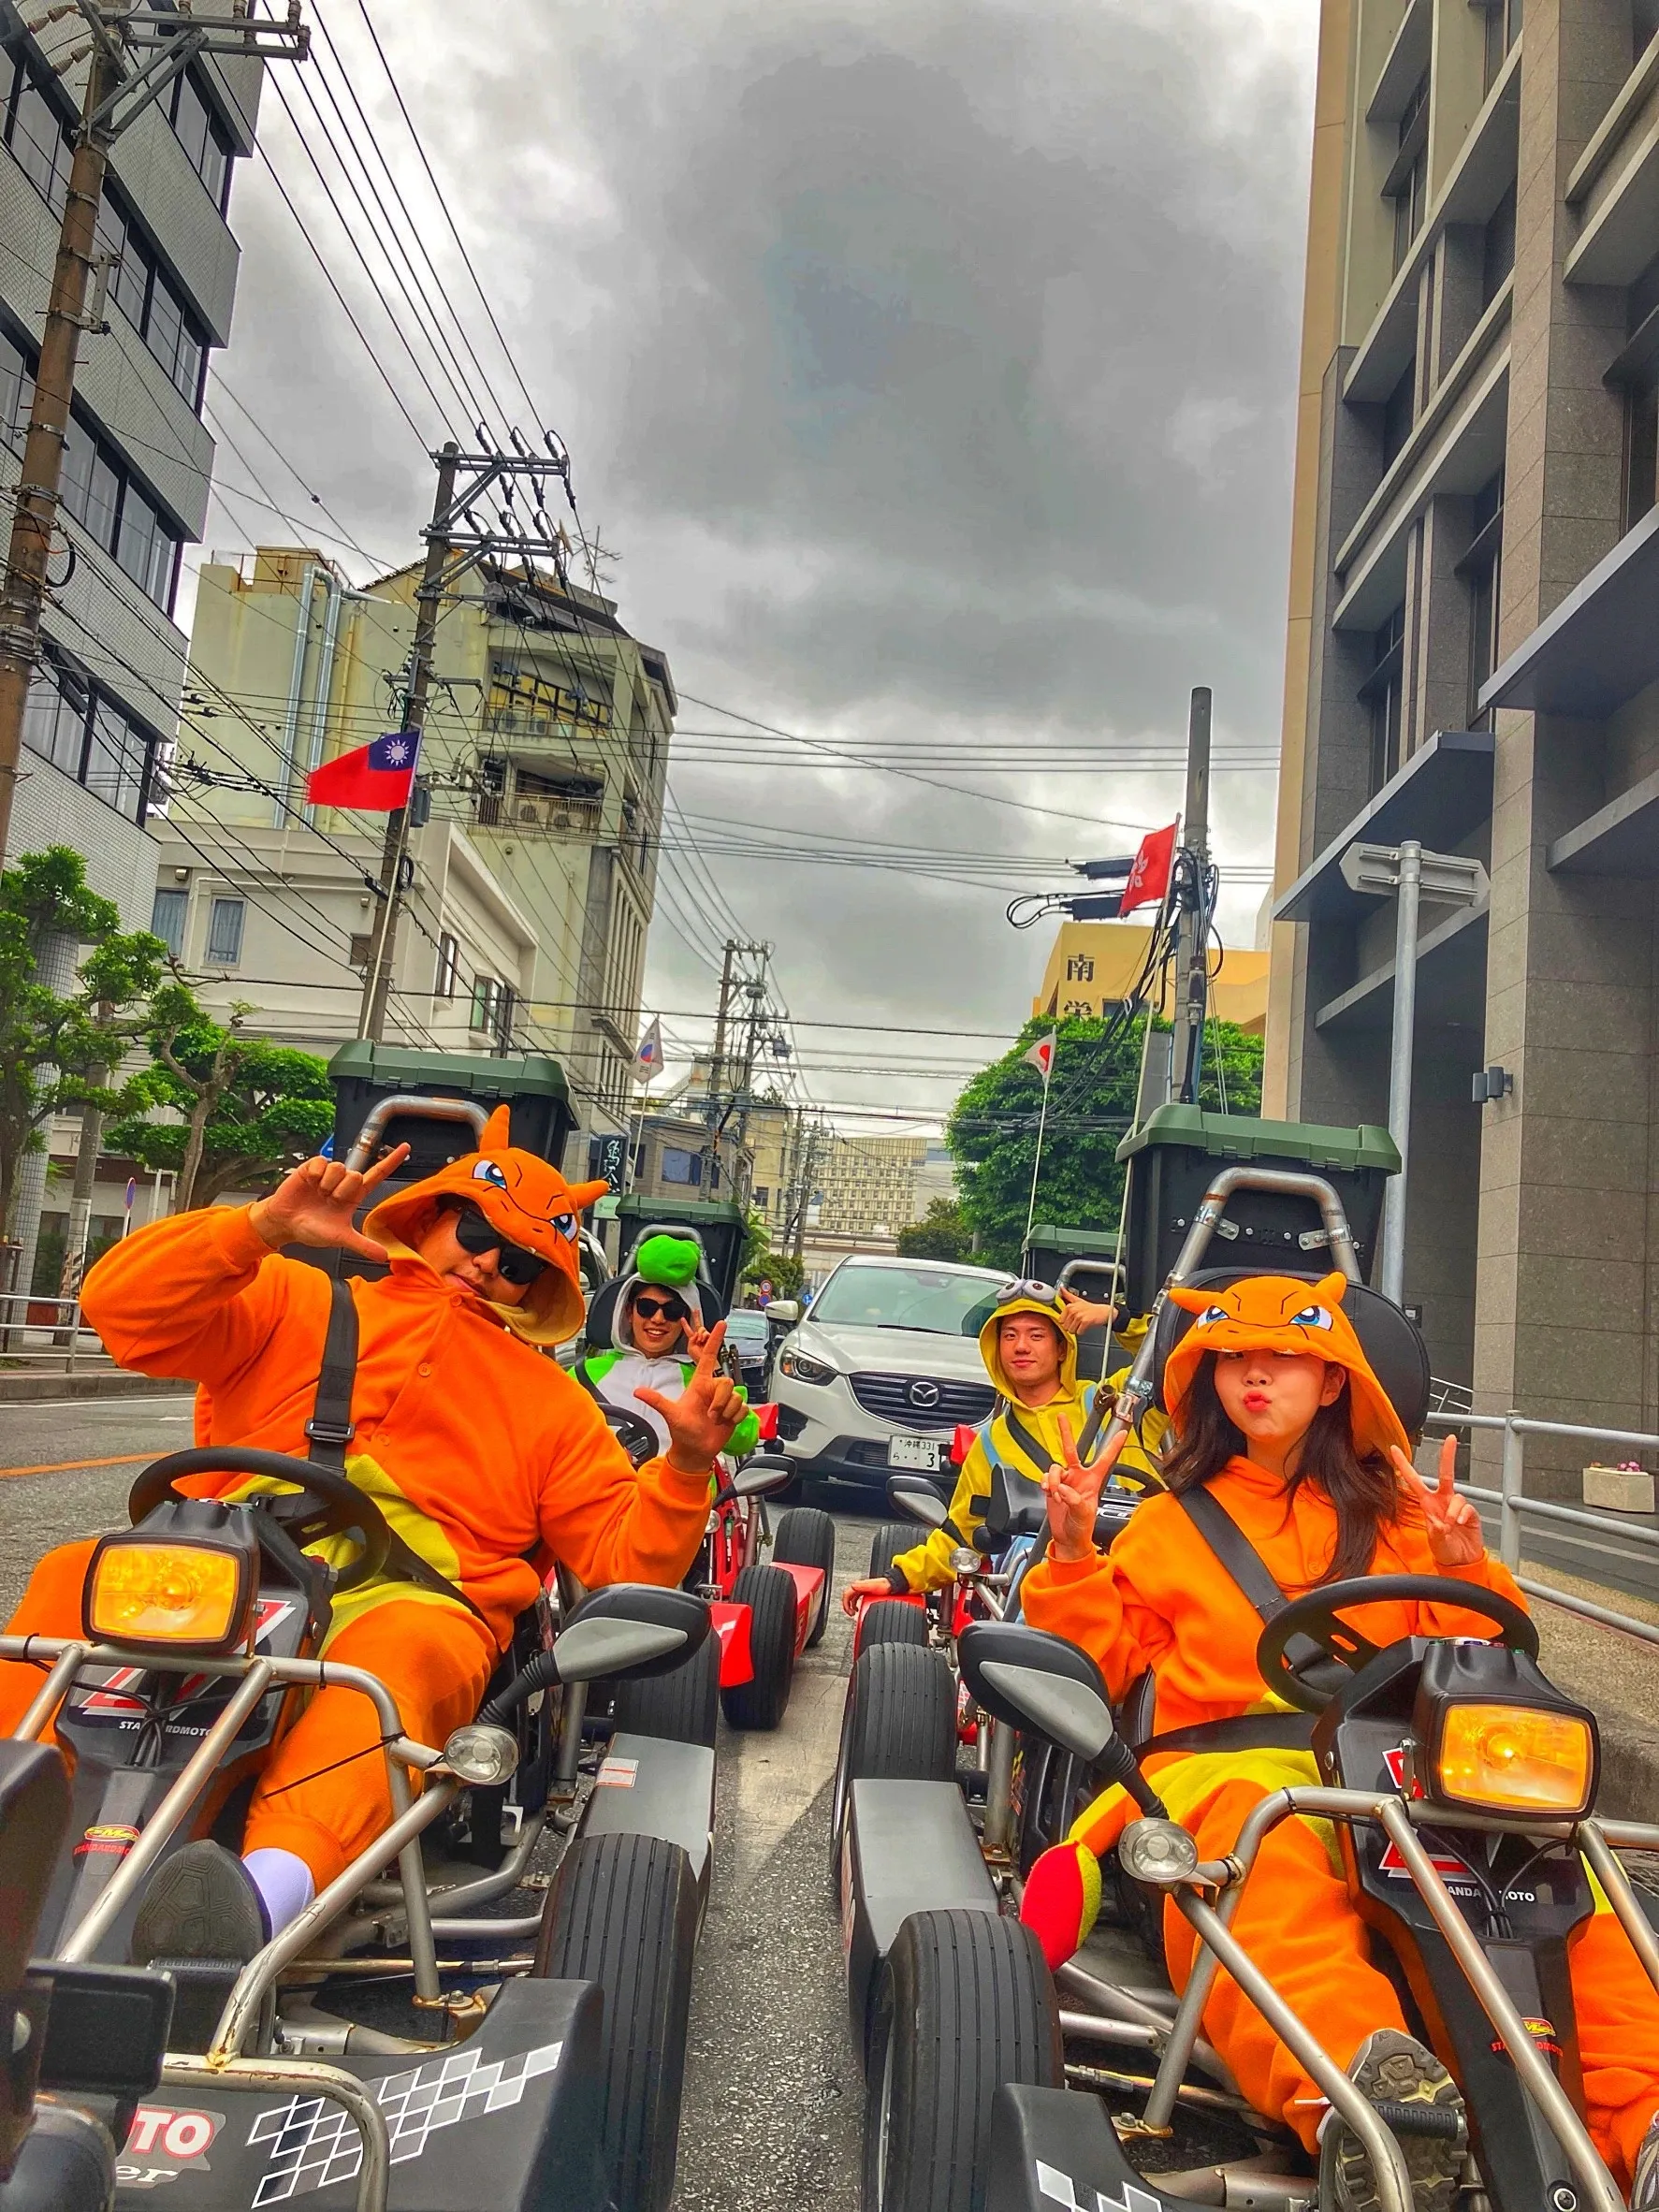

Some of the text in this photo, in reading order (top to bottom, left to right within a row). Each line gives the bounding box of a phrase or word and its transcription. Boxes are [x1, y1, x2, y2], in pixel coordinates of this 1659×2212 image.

[925, 1452, 936, 1468] 3
[133, 2108, 213, 2157] TO
[116, 2165, 179, 2183] er
